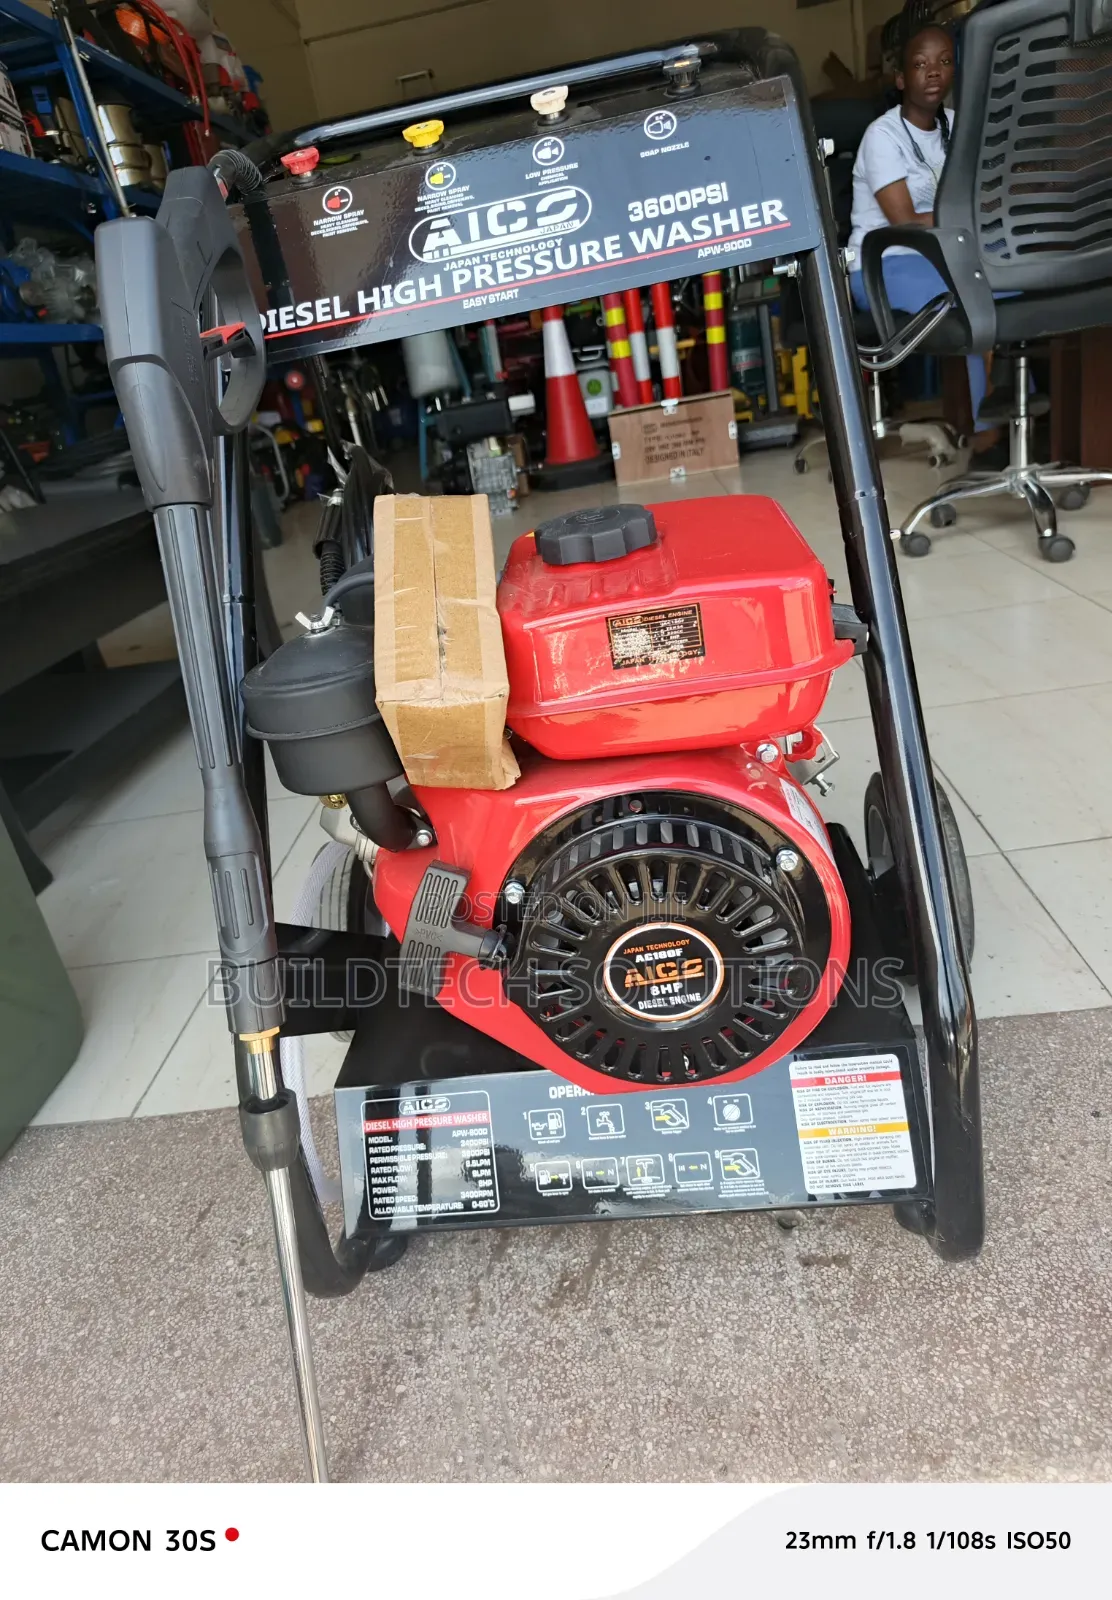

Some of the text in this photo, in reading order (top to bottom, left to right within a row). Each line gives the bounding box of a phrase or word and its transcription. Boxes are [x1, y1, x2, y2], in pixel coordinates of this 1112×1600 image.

[640, 141, 690, 158] SOAP NOZZLE
[525, 162, 579, 180] LOW PRESSURE
[417, 185, 470, 202] NARROW SPRAY
[627, 181, 729, 222] 3600PSI
[313, 209, 365, 226] NARROW SPRAY
[539, 222, 574, 235] JAPAN
[697, 237, 752, 259] APW-900D
[356, 273, 442, 313] HIGH
[452, 234, 624, 293] PRESSURE
[628, 199, 789, 255] WASHER
[443, 237, 564, 272] JAPAN TECHNOLOGY
[462, 288, 519, 309] EASY START
[667, 609, 693, 619] ENGINE
[623, 939, 690, 955] JAPAN TECHNOLOGY
[635, 948, 683, 963] AC180F
[650, 982, 683, 996] 8HP
[638, 992, 702, 1010] DIESEL ENGINE
[824, 1074, 867, 1085] DANGER!
[549, 1085, 595, 1099] OPERA
[644, 1101, 651, 1111] 3
[707, 1096, 713, 1106] 4
[522, 1112, 527, 1120] 1
[580, 1107, 586, 1116] 2
[365, 1112, 488, 1131] DIESEL HIGH PRESSURE WASHER
[828, 1125, 877, 1136] WARNING!
[368, 1136, 393, 1144] MODEL:
[369, 1146, 391, 1154] RATED
[390, 1143, 427, 1153] PRESSURE:
[370, 1154, 412, 1164] PERMISSIBLE
[412, 1151, 448, 1161] PRESSURE:
[668, 1153, 674, 1162] 8
[714, 1150, 720, 1159] 9
[575, 1160, 581, 1169] 6
[619, 1156, 625, 1165] 7
[370, 1166, 392, 1174] RATED
[392, 1164, 413, 1173] FLOW:
[529, 1164, 535, 1172] 5
[607, 1168, 615, 1177] N
[700, 1163, 708, 1171] N
[371, 1176, 387, 1185] MAX
[387, 1175, 408, 1183] FLOW:
[372, 1185, 398, 1194] POWER:
[373, 1196, 395, 1204] RATED
[395, 1194, 418, 1203] SPEED:
[374, 1204, 414, 1215] ALLOWABLE
[414, 1201, 464, 1212] TEMPERATURE:
